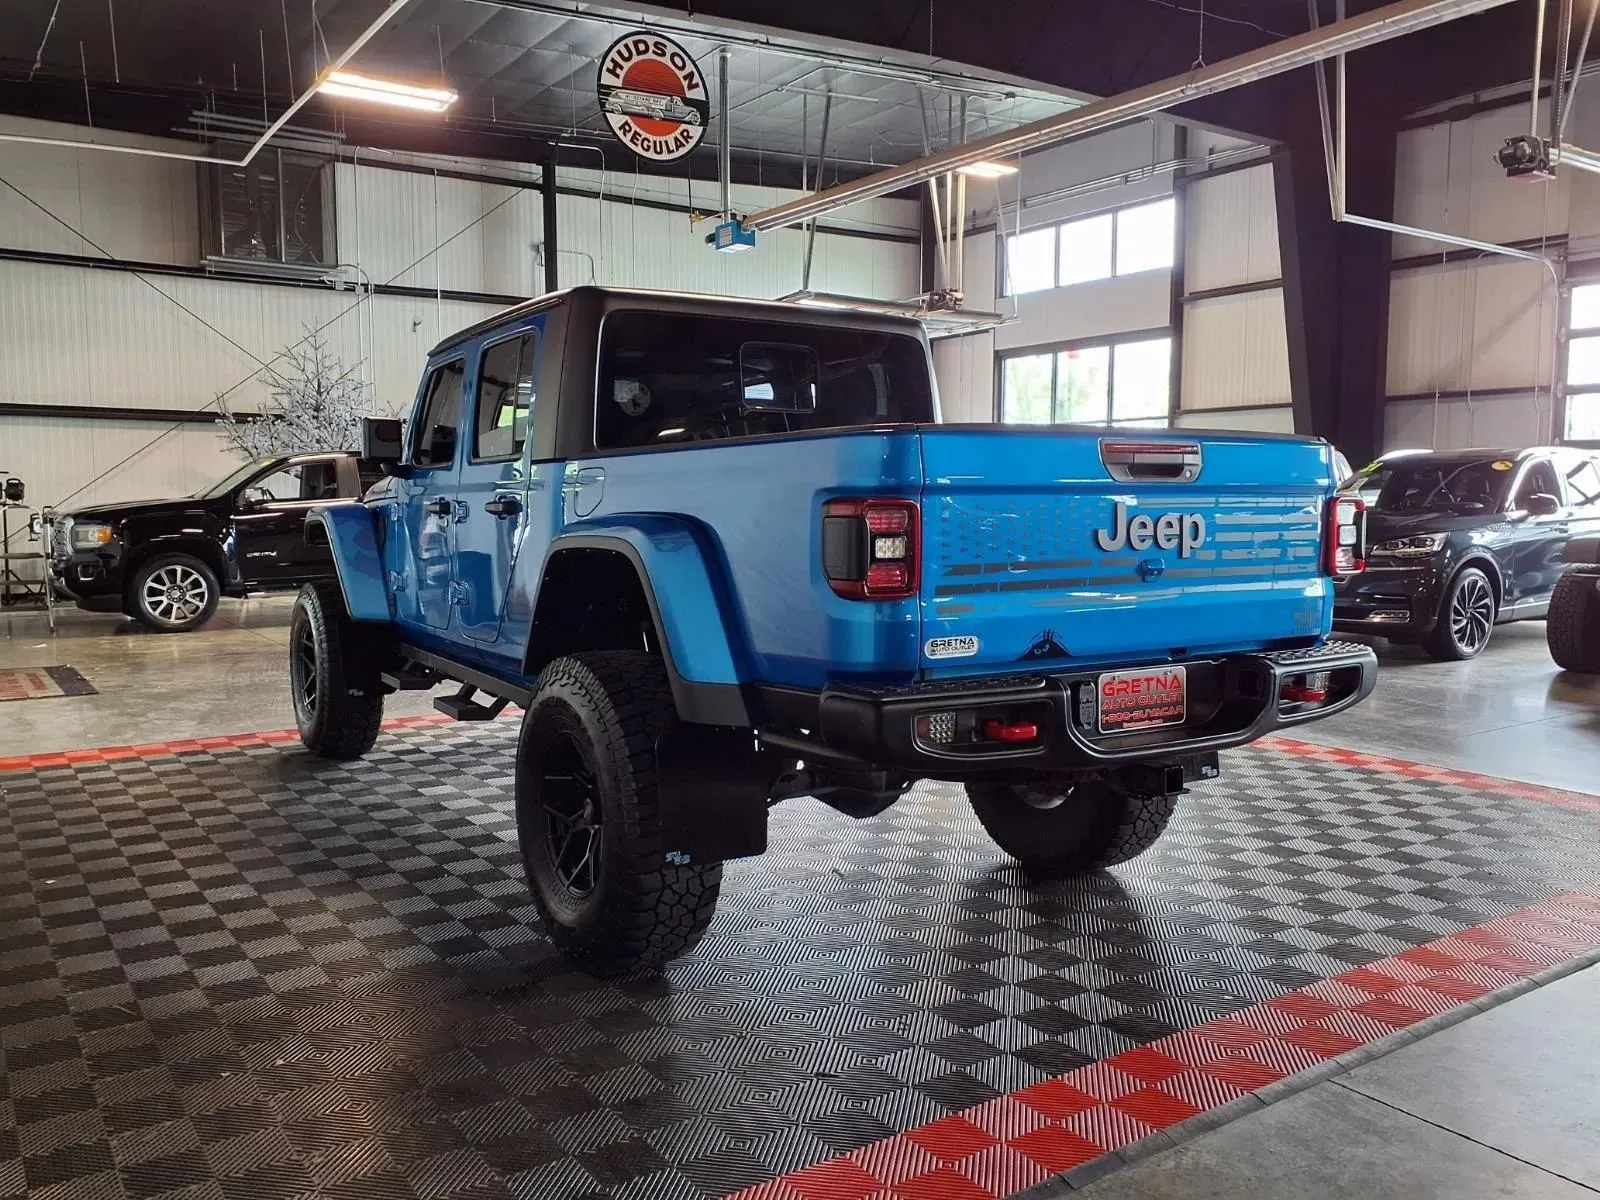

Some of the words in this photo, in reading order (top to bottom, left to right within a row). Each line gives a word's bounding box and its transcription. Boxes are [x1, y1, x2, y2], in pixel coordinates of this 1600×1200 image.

[605, 38, 700, 92] HUDSON
[618, 120, 694, 155] REGULAR
[1096, 501, 1206, 559] Jeep
[931, 638, 974, 647] GRETNA
[1102, 674, 1183, 697] GRETNA
[1102, 697, 1136, 710] AUTO
[1138, 692, 1184, 706] OUTLET
